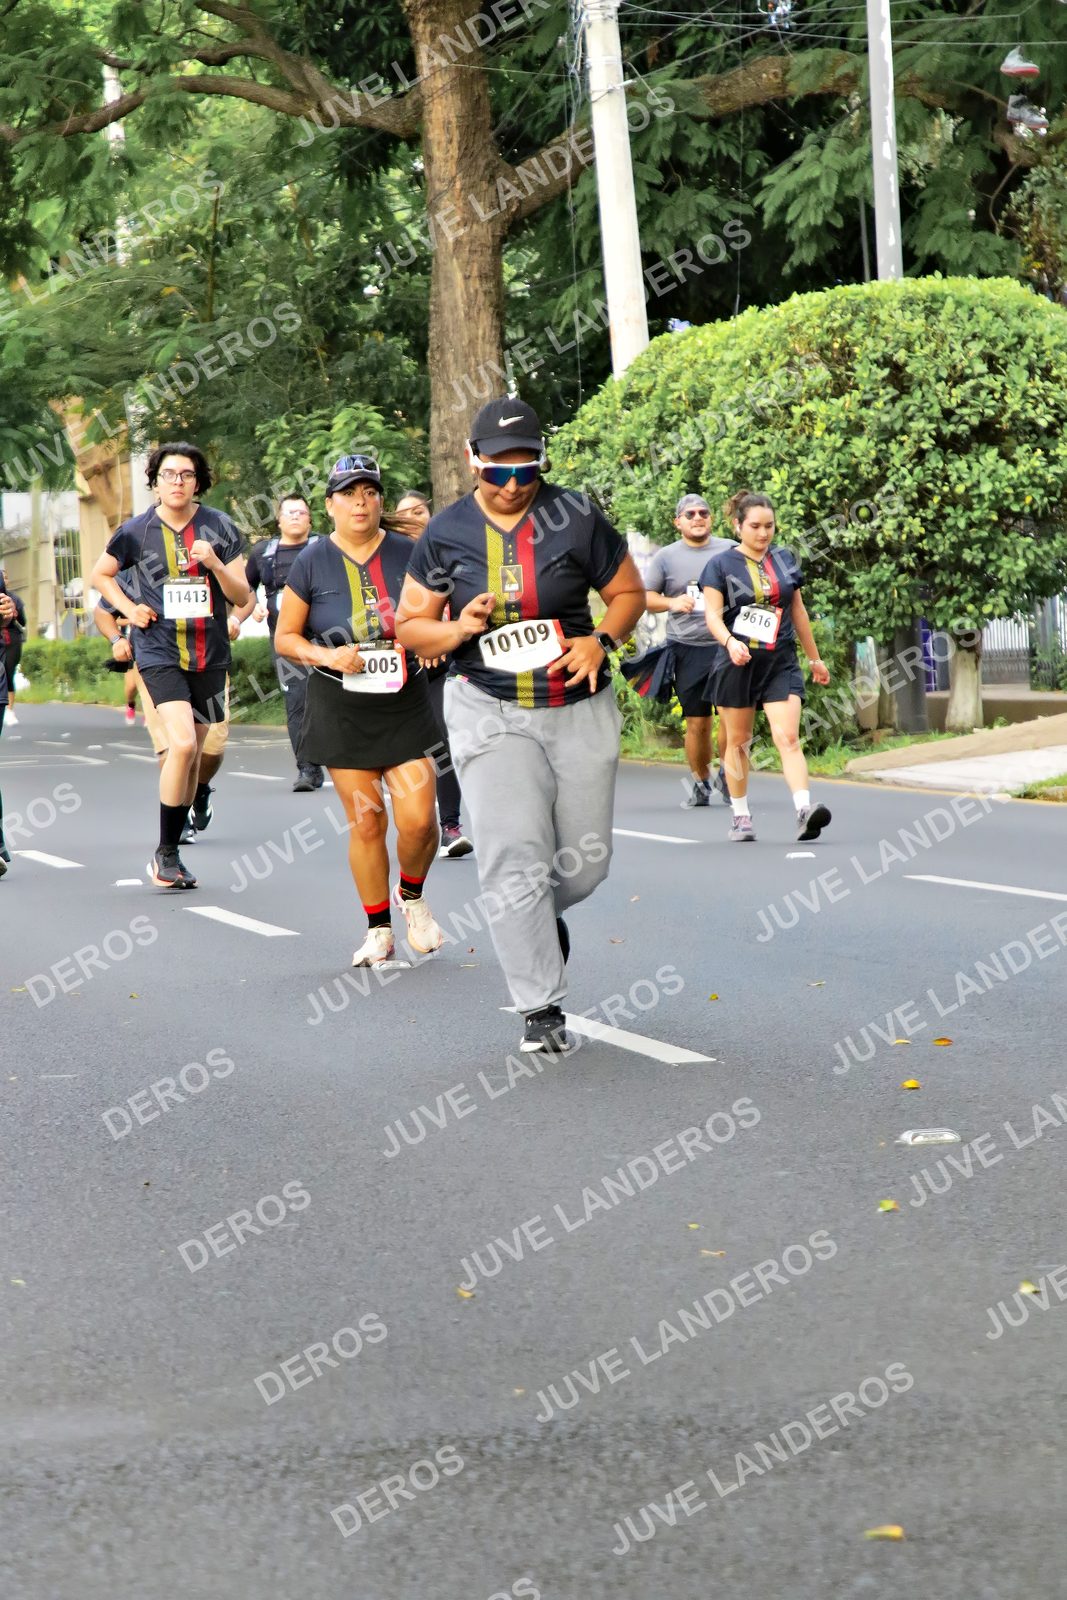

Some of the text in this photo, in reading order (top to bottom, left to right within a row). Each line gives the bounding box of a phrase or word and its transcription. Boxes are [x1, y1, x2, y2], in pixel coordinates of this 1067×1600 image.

[168, 590, 208, 603] 11413
[743, 611, 771, 628] 9616
[484, 623, 550, 656] 10109
